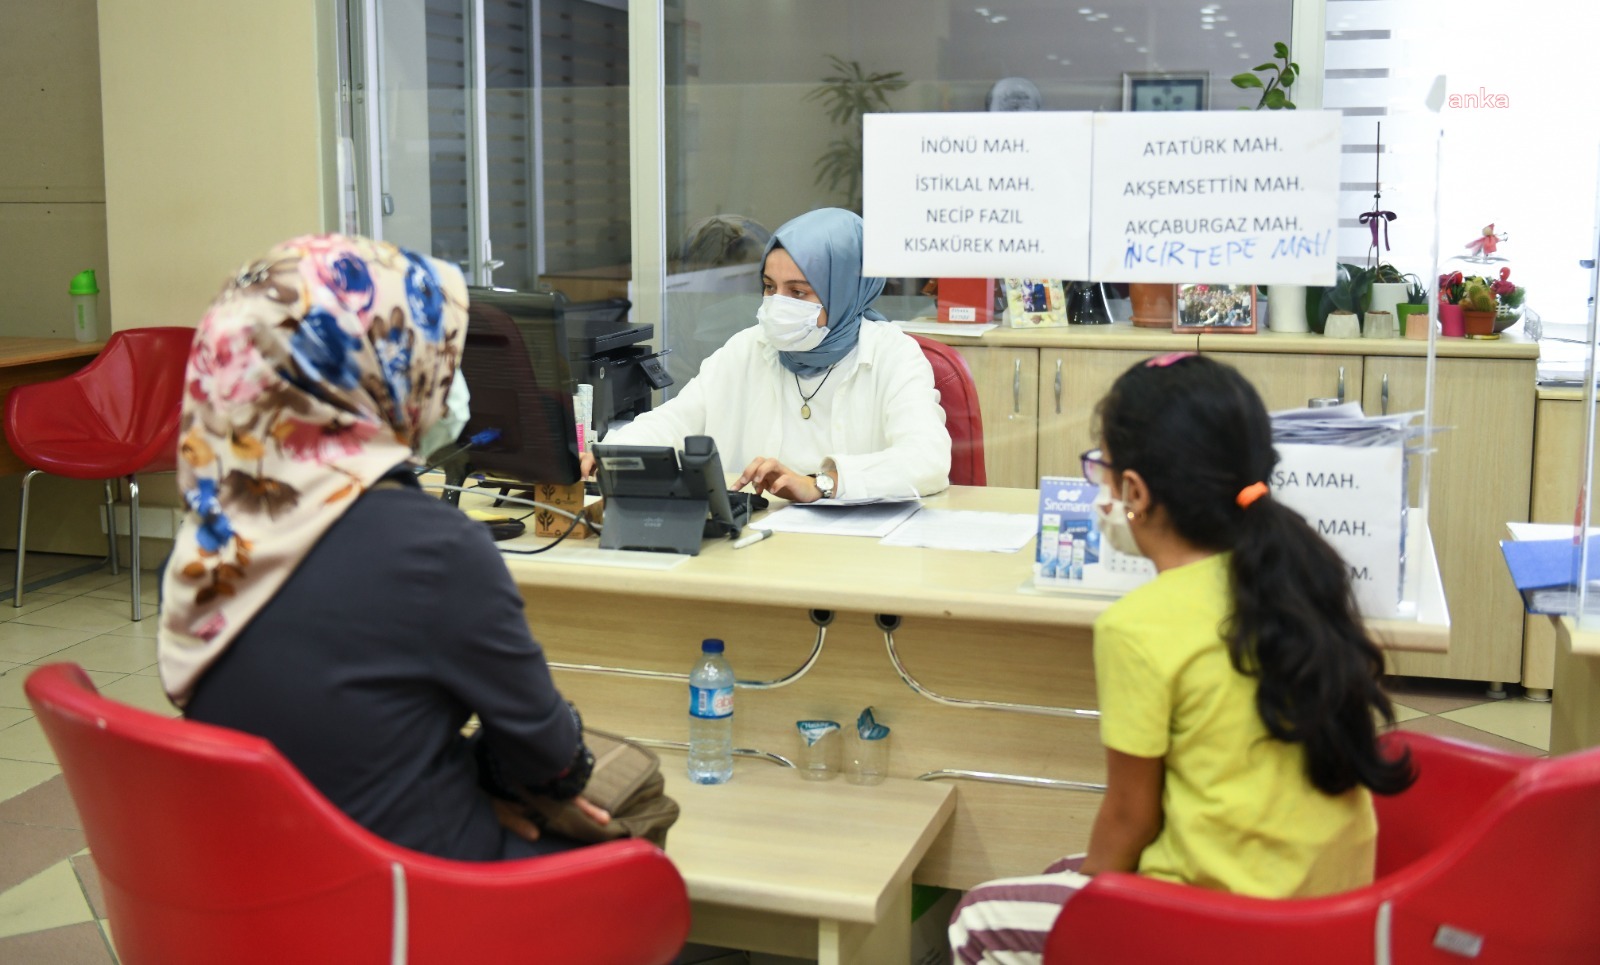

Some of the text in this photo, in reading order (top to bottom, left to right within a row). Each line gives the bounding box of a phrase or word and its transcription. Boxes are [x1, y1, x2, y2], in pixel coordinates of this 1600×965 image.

[921, 136, 1029, 154] İNÖNÜ MAH.
[1143, 137, 1284, 157] ATATÜRK MAH.
[915, 173, 1034, 192] İSTİKLAL MAH.
[1123, 175, 1305, 199] AKŞEMSETTİN MAH.
[926, 205, 1024, 224] NECİP FAZIL
[1124, 216, 1303, 237] AKÇABURGAZ MAH.
[904, 235, 1045, 254] KISAKÜREK MAH.
[1306, 472, 1360, 489] MAH.
[1318, 519, 1371, 537] MAH.
